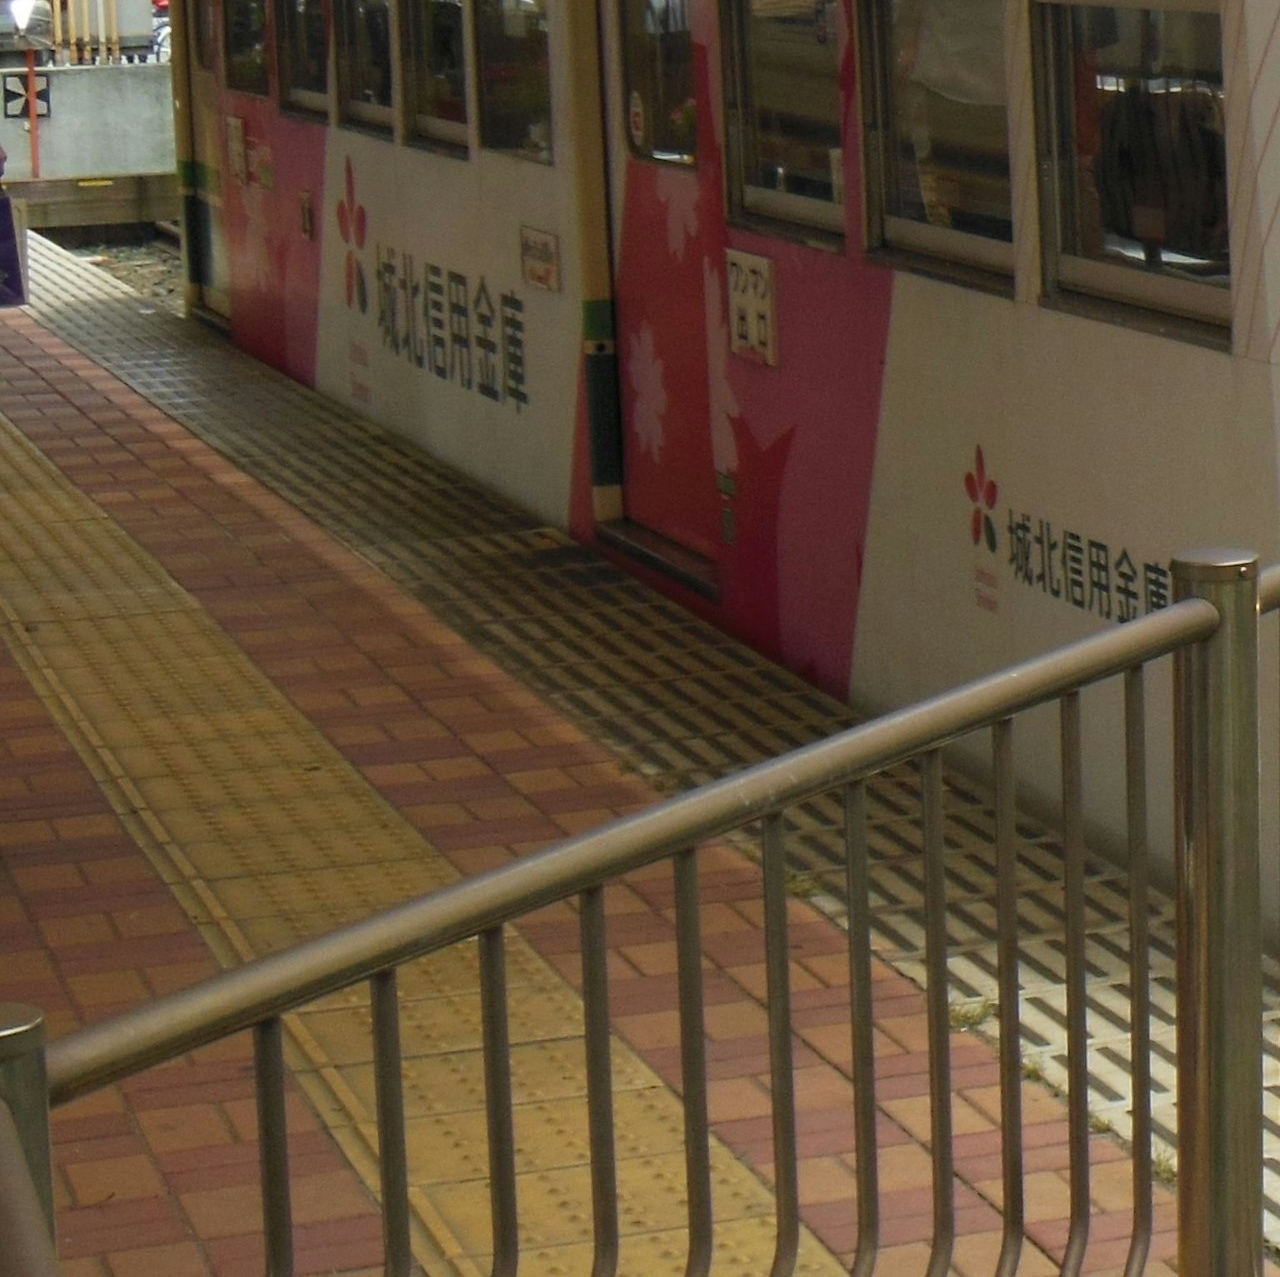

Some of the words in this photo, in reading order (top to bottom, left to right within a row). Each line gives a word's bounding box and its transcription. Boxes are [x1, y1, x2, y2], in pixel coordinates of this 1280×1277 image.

[375, 242, 529, 414] 城北信用金庫
